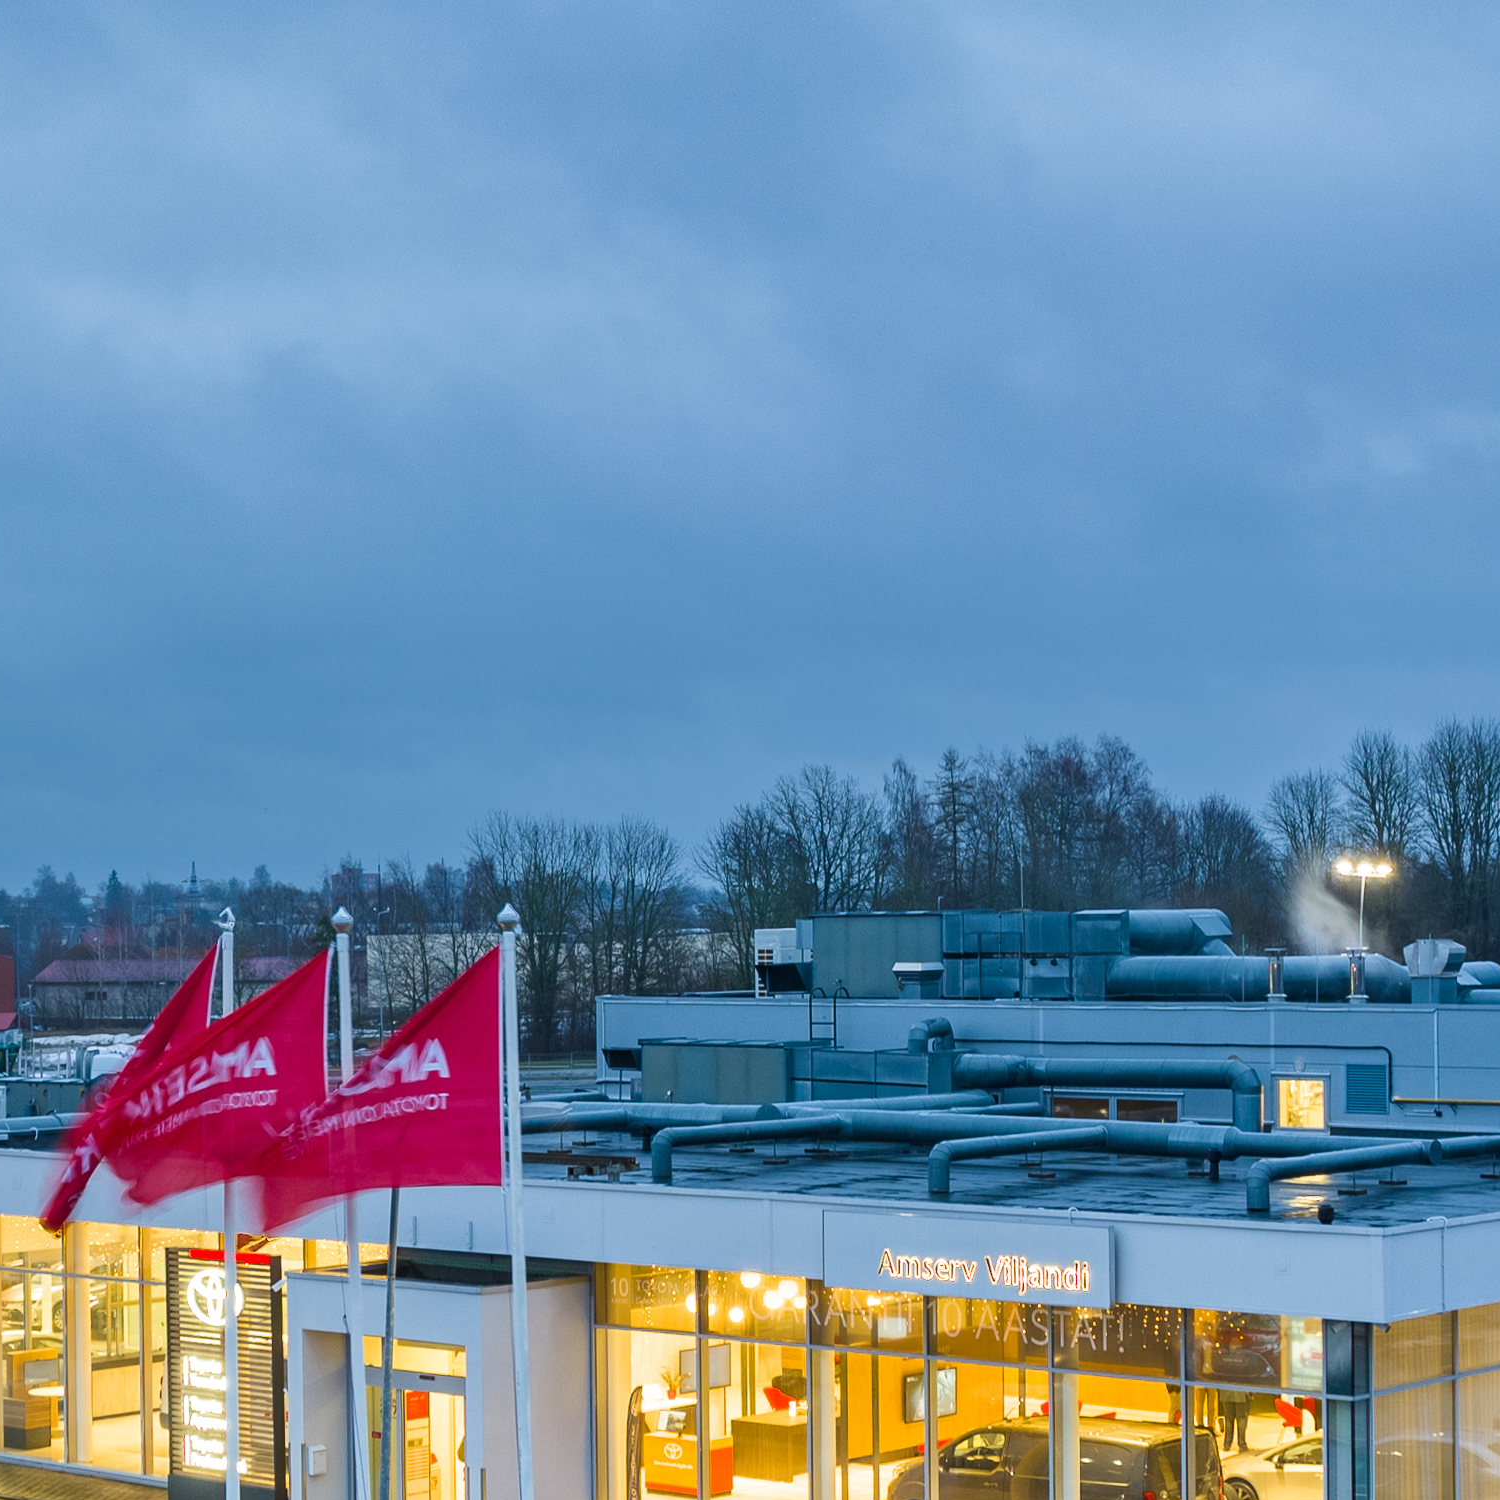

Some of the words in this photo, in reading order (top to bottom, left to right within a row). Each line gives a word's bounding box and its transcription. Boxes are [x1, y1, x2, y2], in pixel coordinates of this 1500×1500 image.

[878, 1248, 978, 1284] Amserv
[984, 1254, 1092, 1296] Viljandi
[749, 1288, 913, 1333] GARANTII
[927, 1302, 963, 1338] 10
[976, 1304, 1126, 1354] AASTAT!
